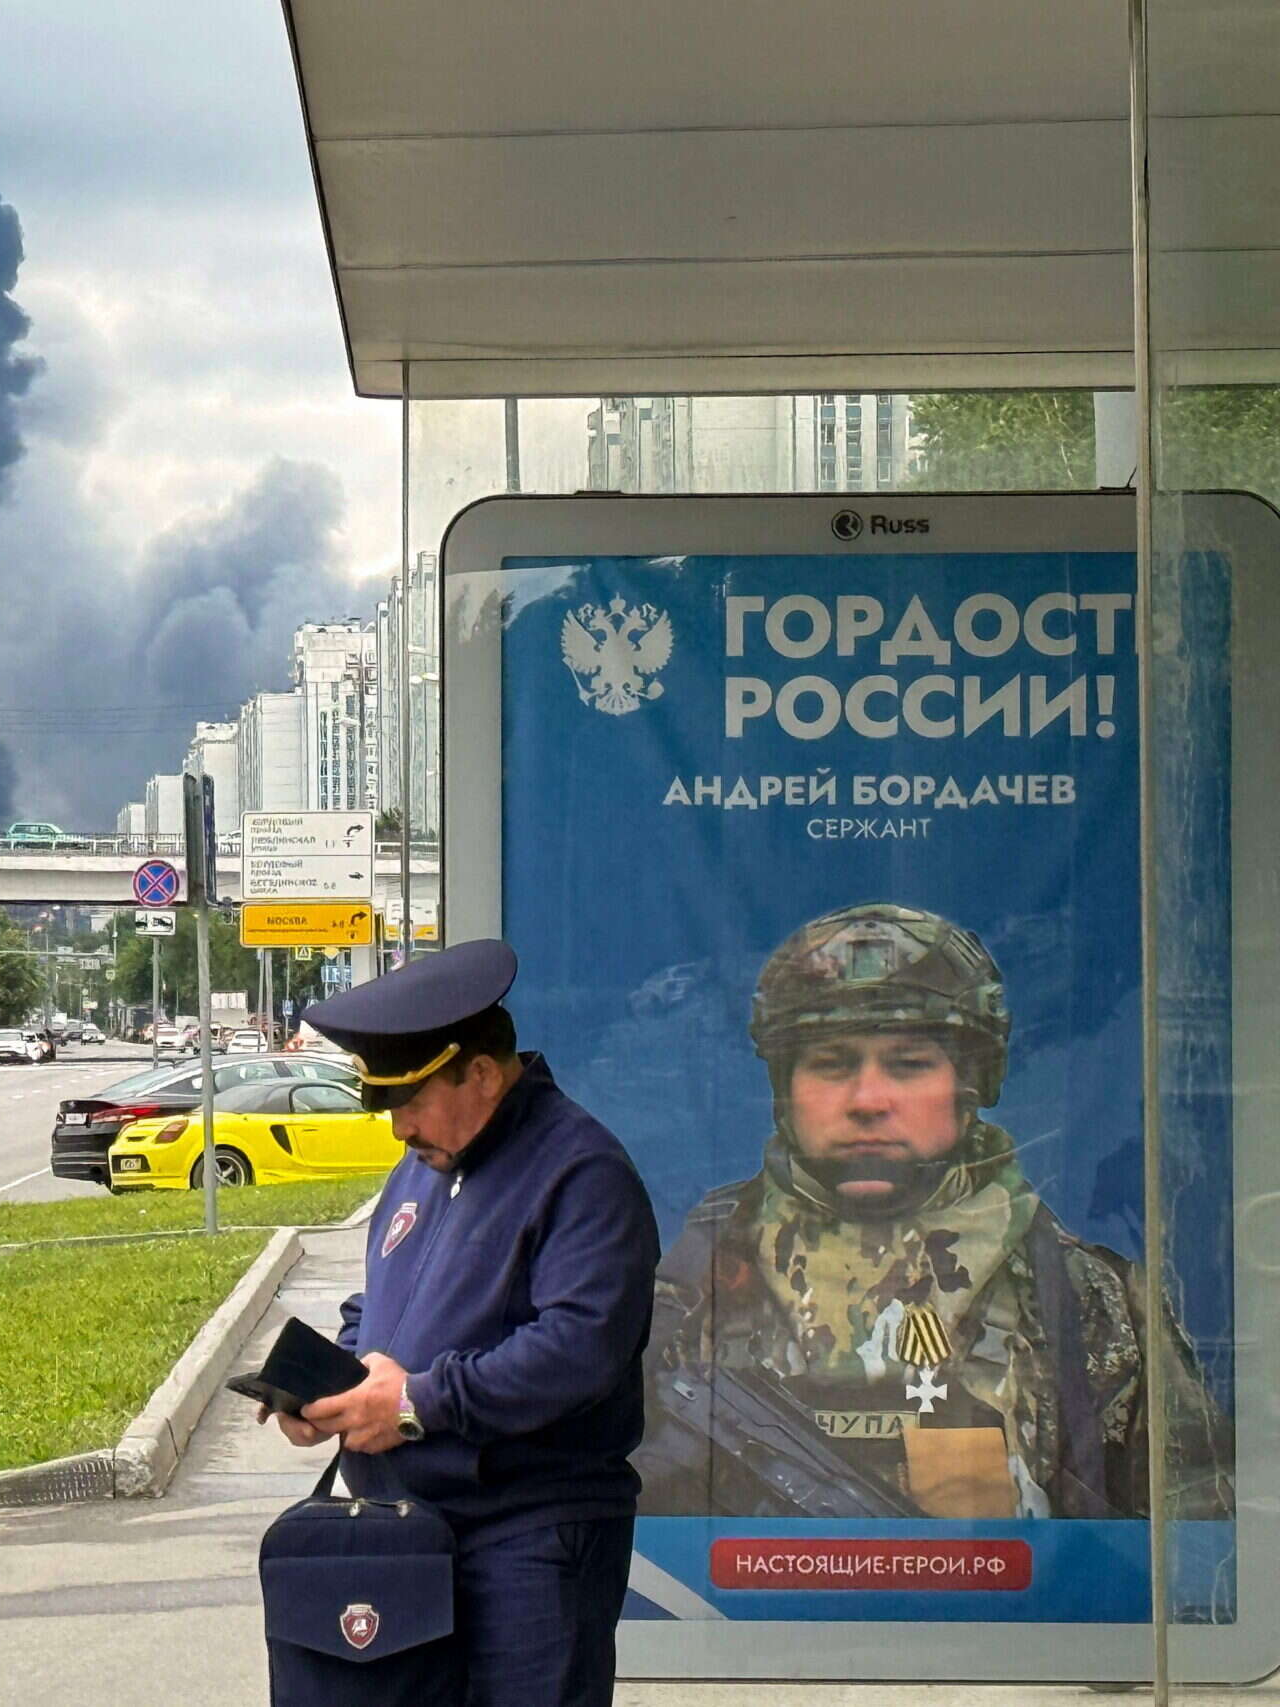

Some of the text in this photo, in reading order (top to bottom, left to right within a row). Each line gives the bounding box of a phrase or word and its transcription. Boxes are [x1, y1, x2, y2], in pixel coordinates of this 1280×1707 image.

[870, 514, 930, 535] Russ
[724, 592, 1139, 666] ГОРДОСТ
[724, 673, 1116, 740] РОССИИ!
[662, 767, 1077, 810] АНДРЕЙ БОРДАЧЕВ
[806, 816, 933, 840] СЕРЖАНТ
